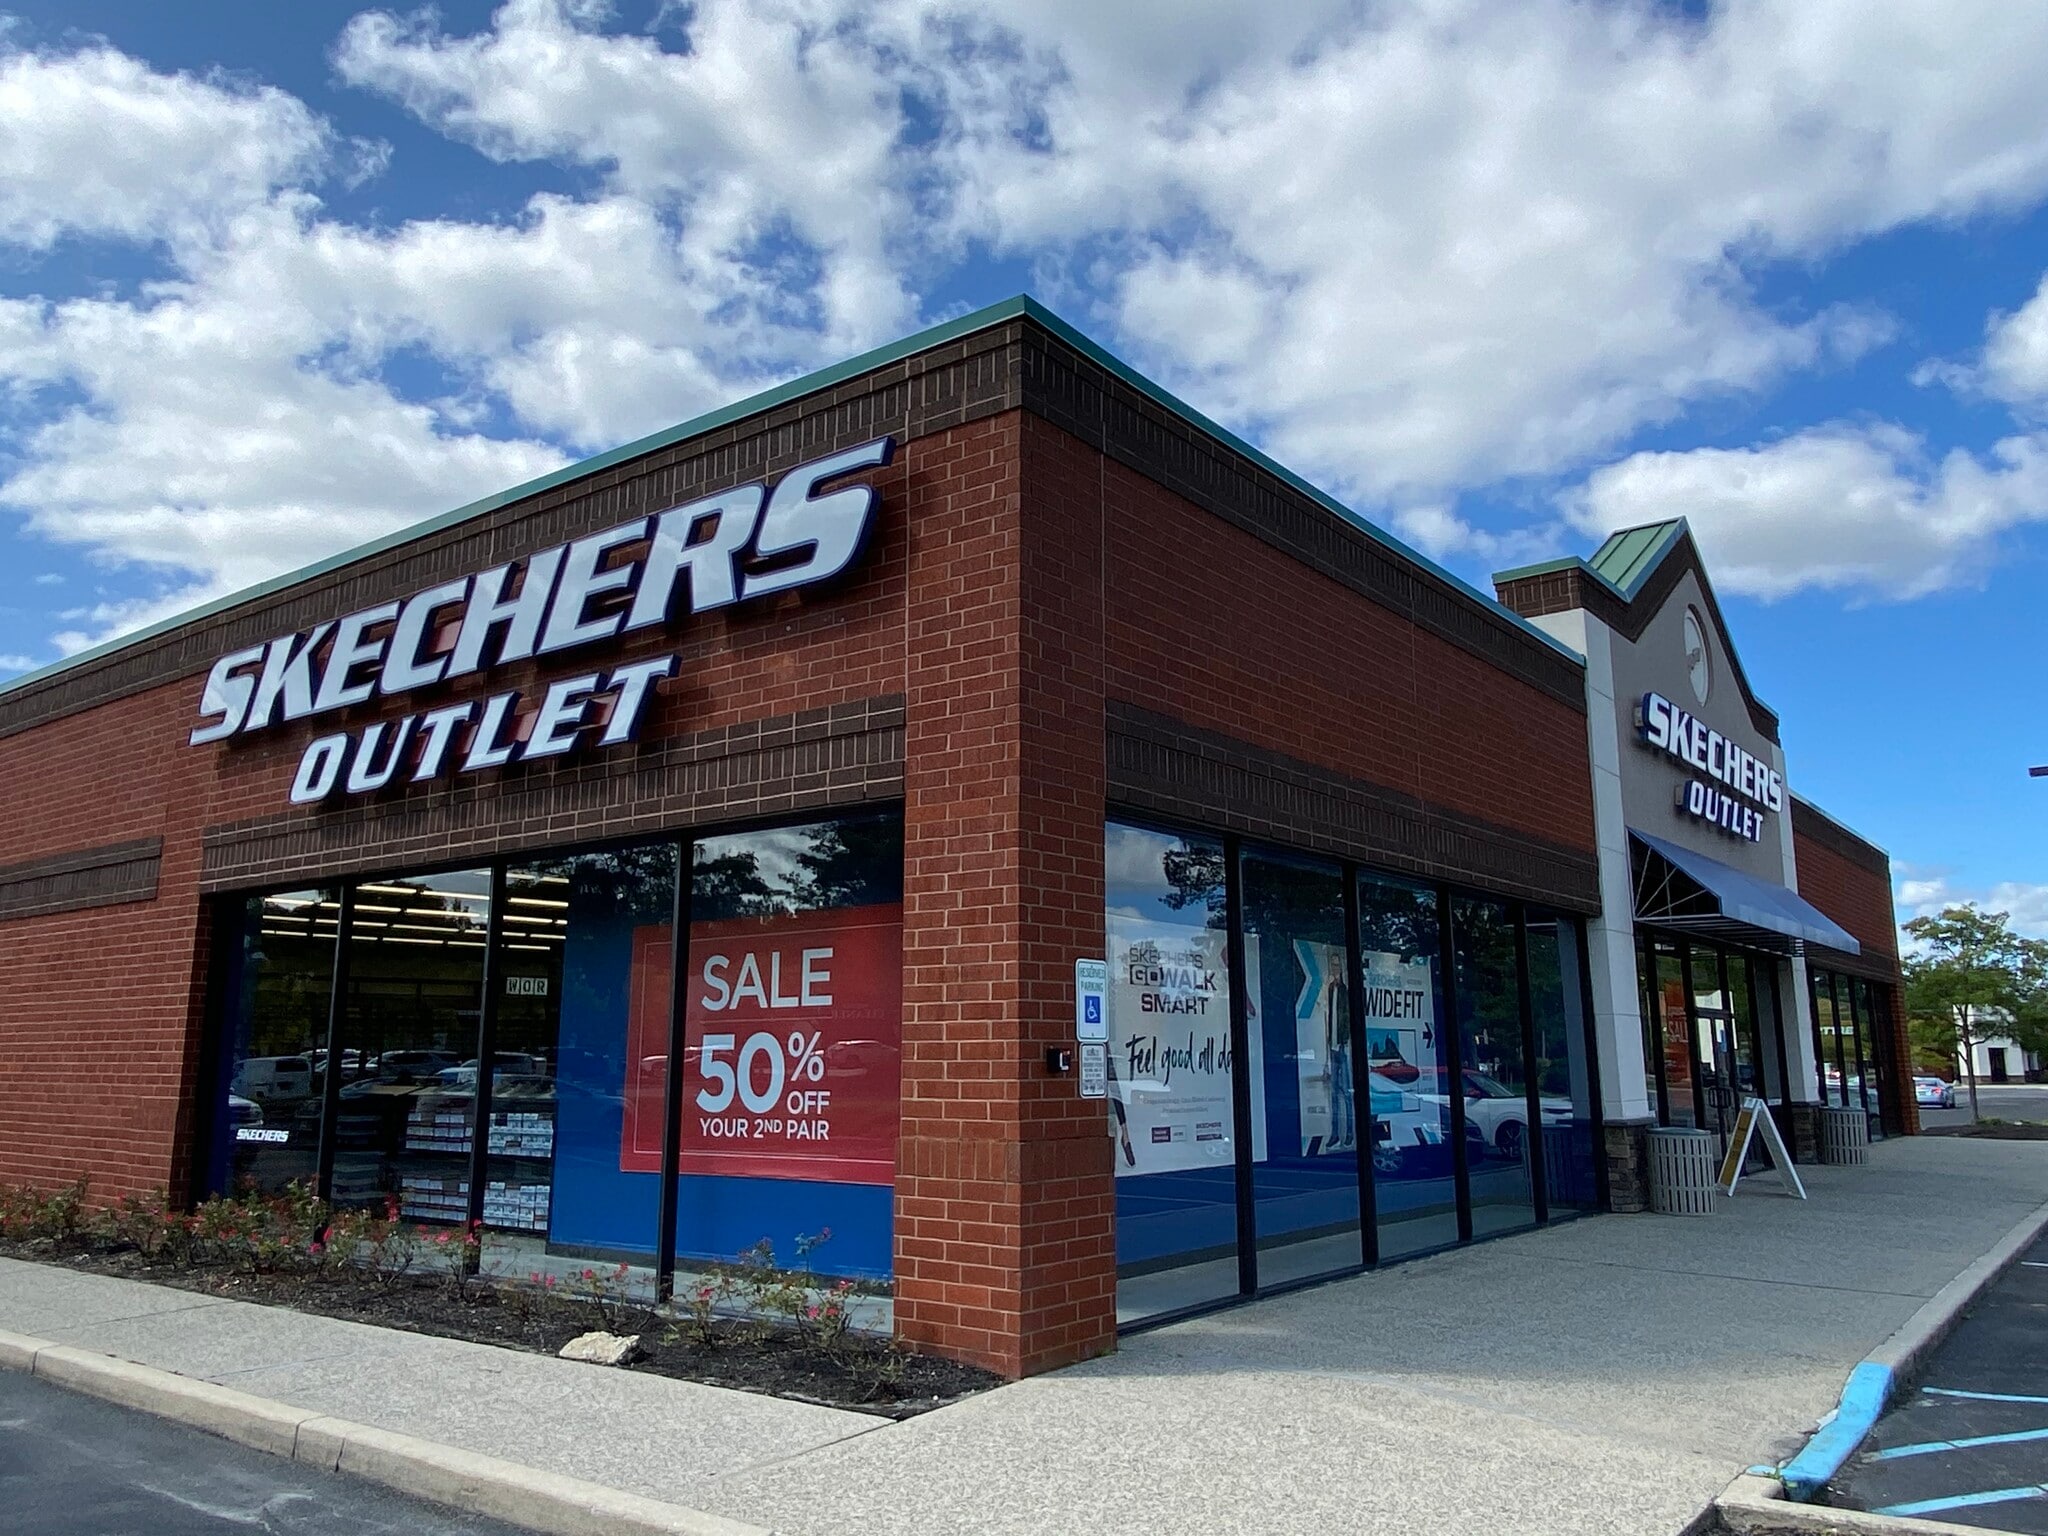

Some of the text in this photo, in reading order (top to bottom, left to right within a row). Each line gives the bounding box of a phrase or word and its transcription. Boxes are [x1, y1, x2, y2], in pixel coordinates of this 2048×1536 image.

[189, 437, 891, 745] SKECHERS
[290, 655, 680, 804] OUTLET
[1643, 692, 1782, 812] SKECHERS
[1684, 780, 1763, 842] OUTLET
[701, 947, 834, 1011] SALE
[1141, 993, 1209, 1015] SMART
[696, 1031, 831, 1115] 50% OFF
[1125, 1033, 1157, 1082] Feel
[1161, 1031, 1195, 1087] good
[1198, 1036, 1214, 1075] all
[236, 1128, 290, 1143] SKECHERS
[699, 1117, 830, 1141] YOUR 2ND PAIR
